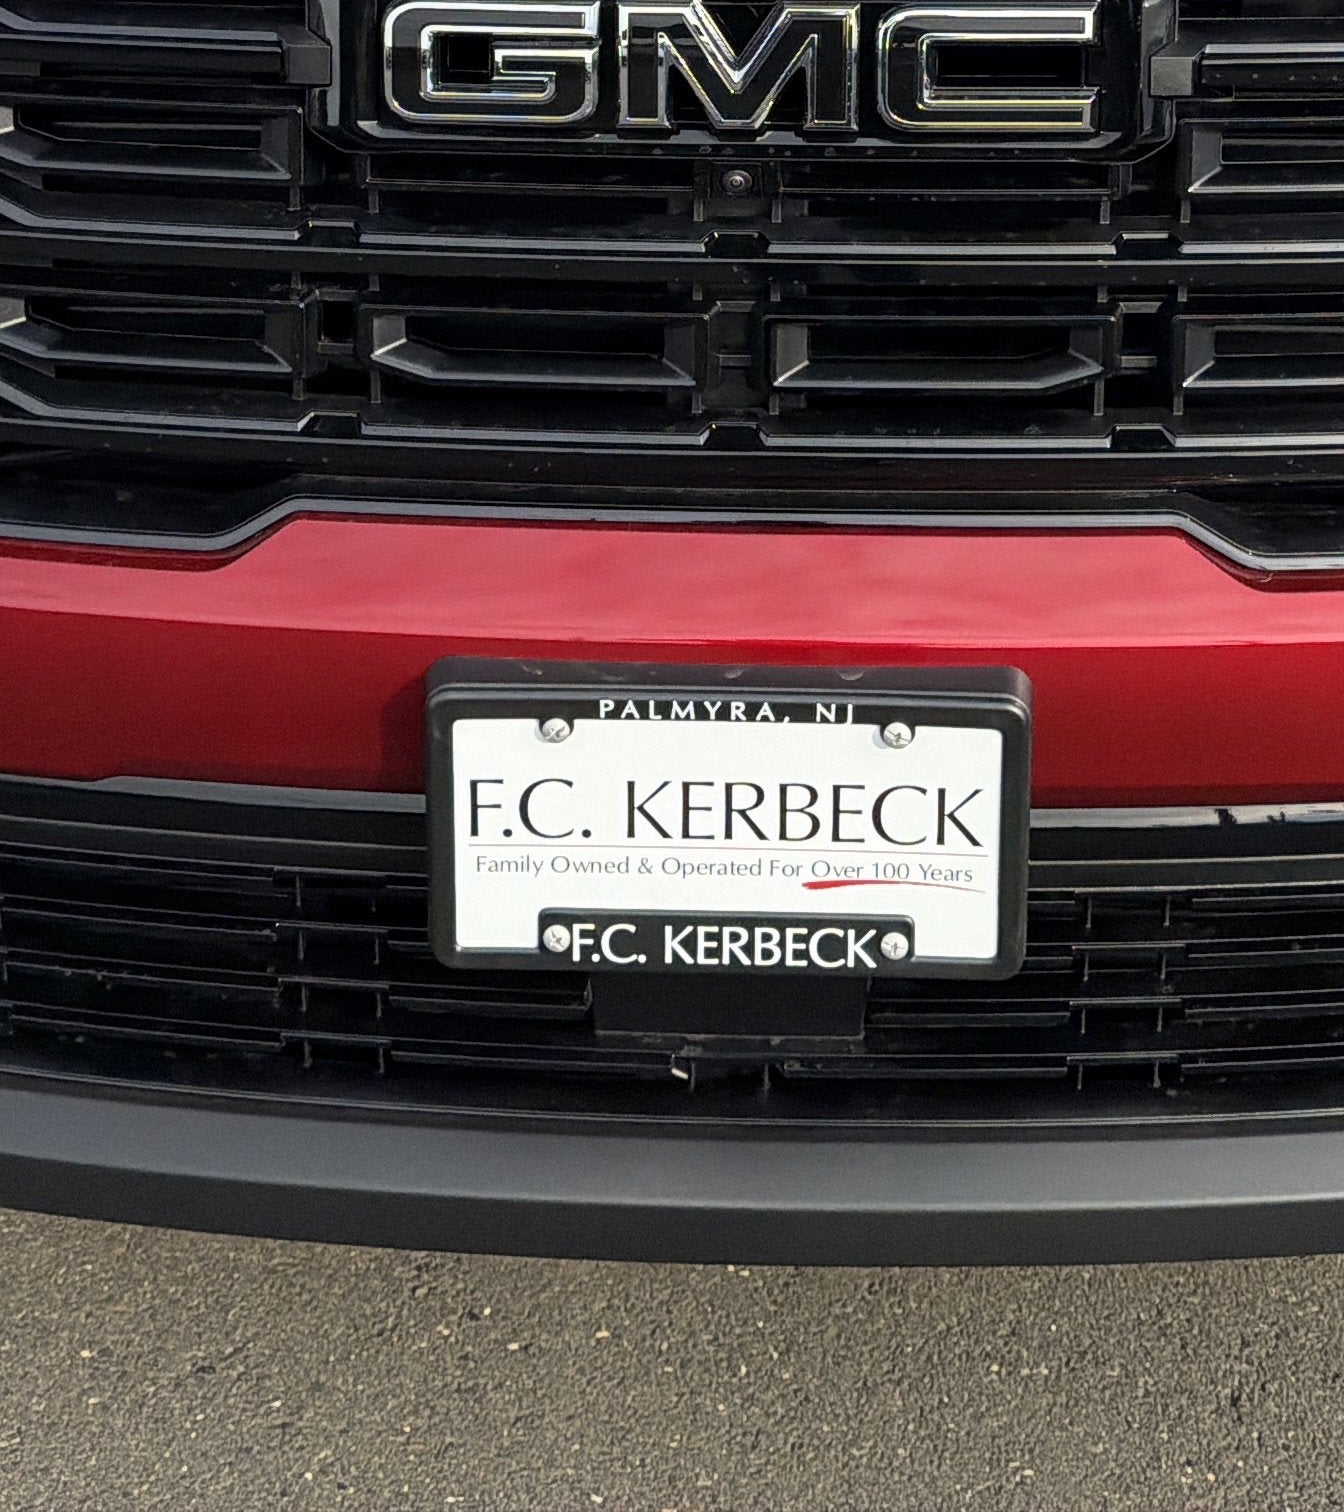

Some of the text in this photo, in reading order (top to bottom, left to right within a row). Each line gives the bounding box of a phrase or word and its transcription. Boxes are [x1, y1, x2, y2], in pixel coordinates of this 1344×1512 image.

[599, 699, 854, 725] PALMYRA, NJ
[469, 777, 985, 848] F.C. KERBECK
[476, 855, 974, 883] Family Owned & Operated For Over 100 Years
[572, 923, 878, 969] F.C. KERBECK
